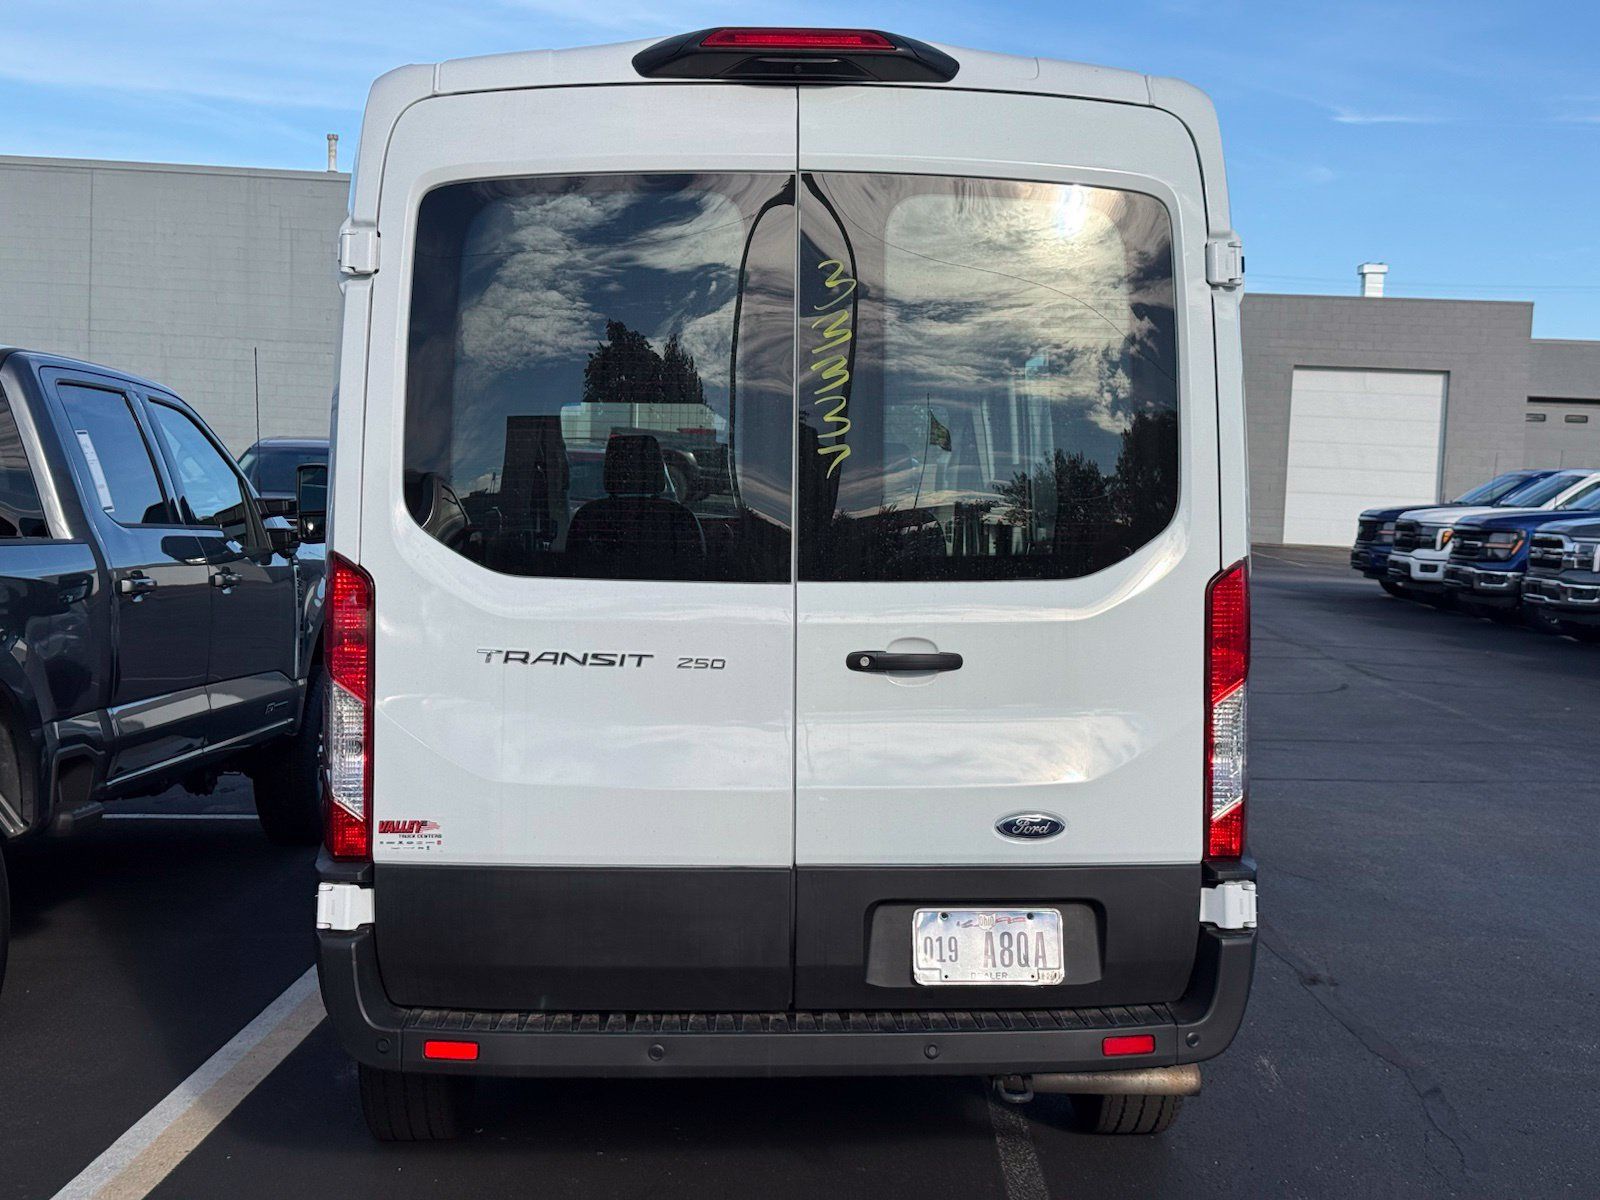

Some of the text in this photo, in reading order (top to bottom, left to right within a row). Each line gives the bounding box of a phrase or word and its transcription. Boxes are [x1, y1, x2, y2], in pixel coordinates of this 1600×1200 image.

[476, 648, 727, 670] TRANSIT 250
[378, 820, 422, 833] VALLEY
[1012, 817, 1051, 835] Ford
[923, 931, 1048, 969] 019 A8QA
[970, 971, 1008, 979] DALER
